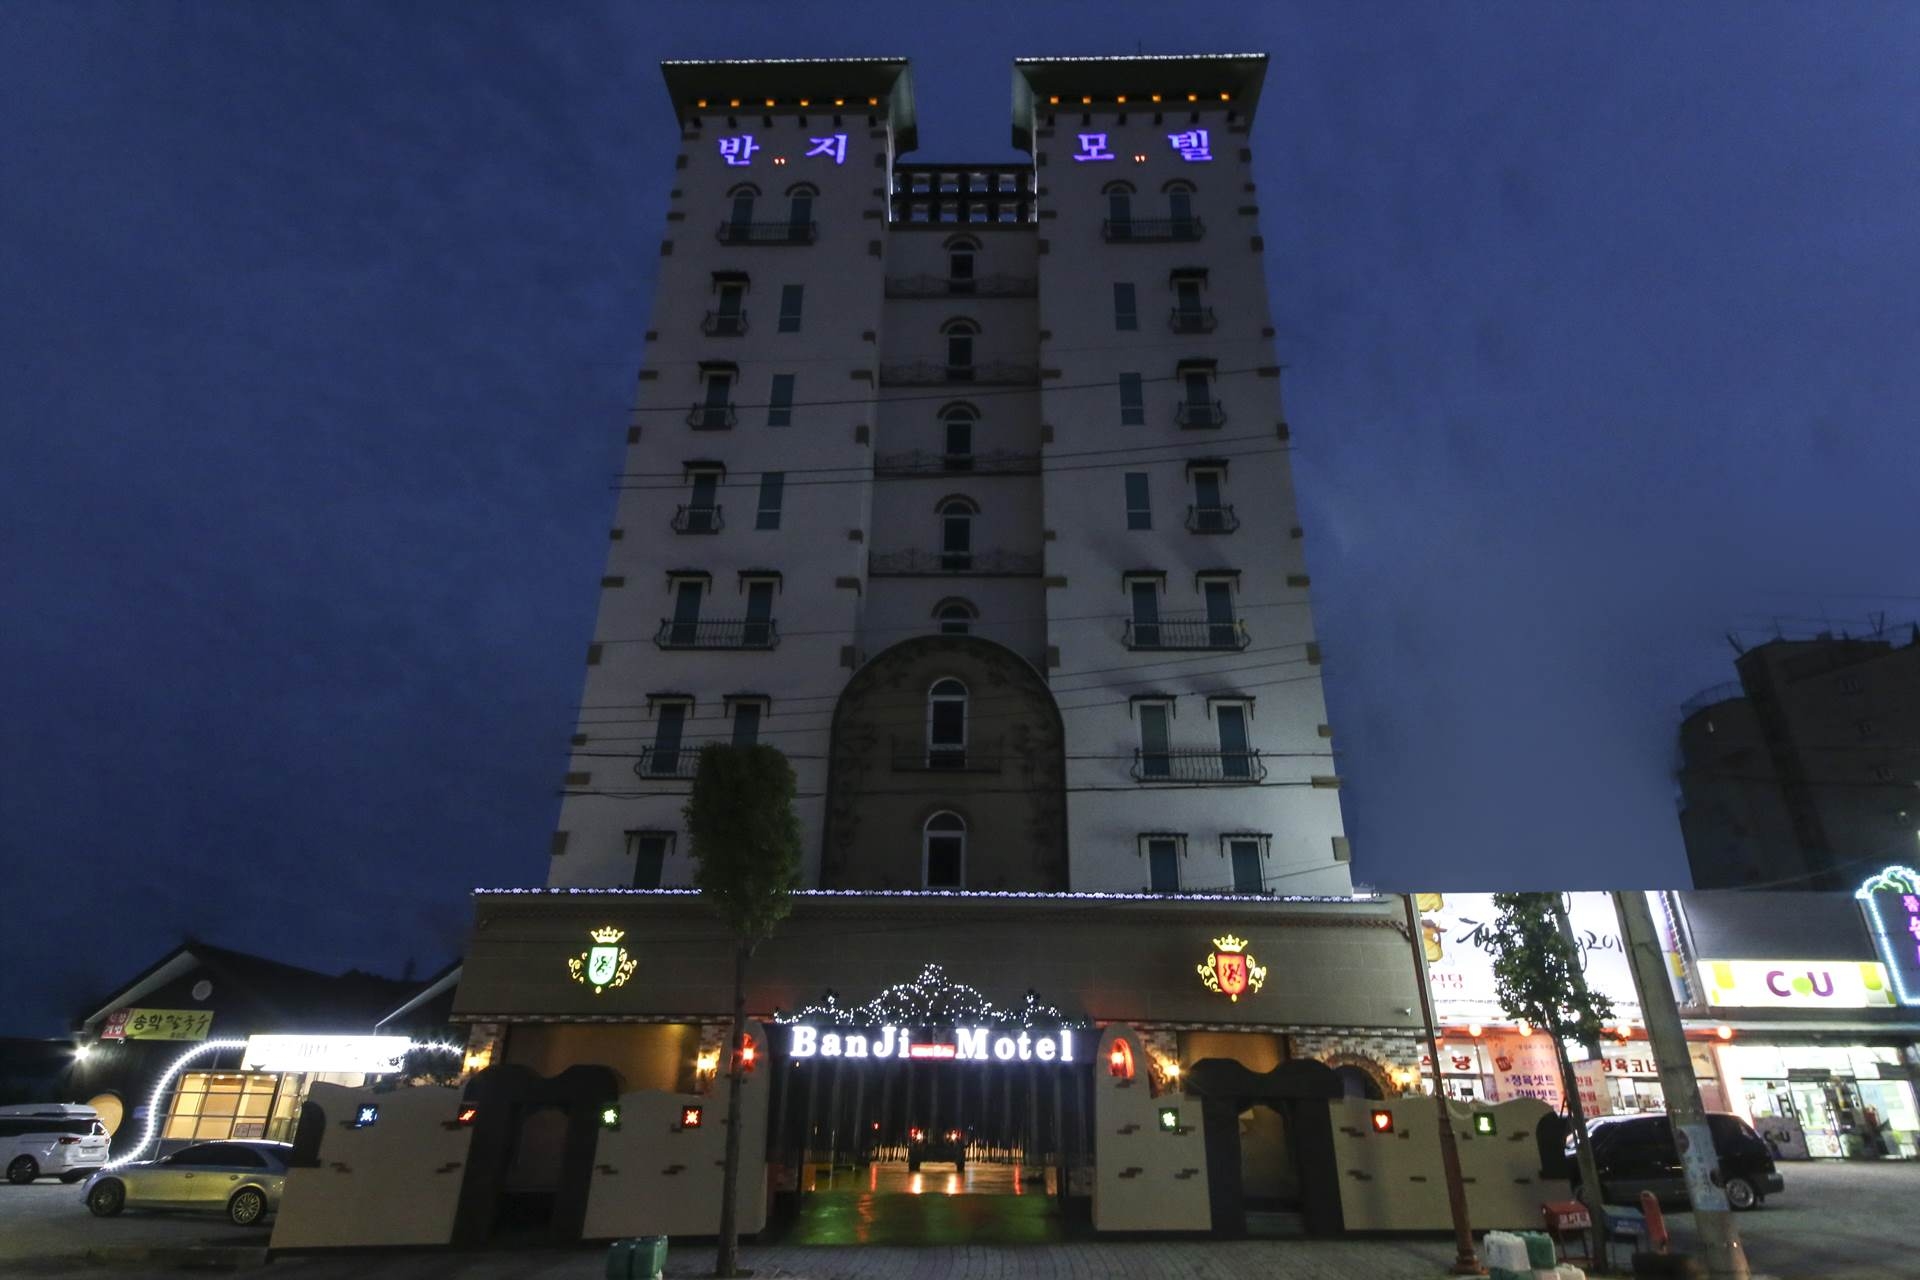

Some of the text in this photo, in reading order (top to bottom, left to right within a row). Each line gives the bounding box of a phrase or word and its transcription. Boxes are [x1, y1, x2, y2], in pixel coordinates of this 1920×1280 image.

[1766, 969, 1836, 997] CU
[790, 1026, 910, 1059] BanJi
[955, 1028, 1073, 1061] Motel
